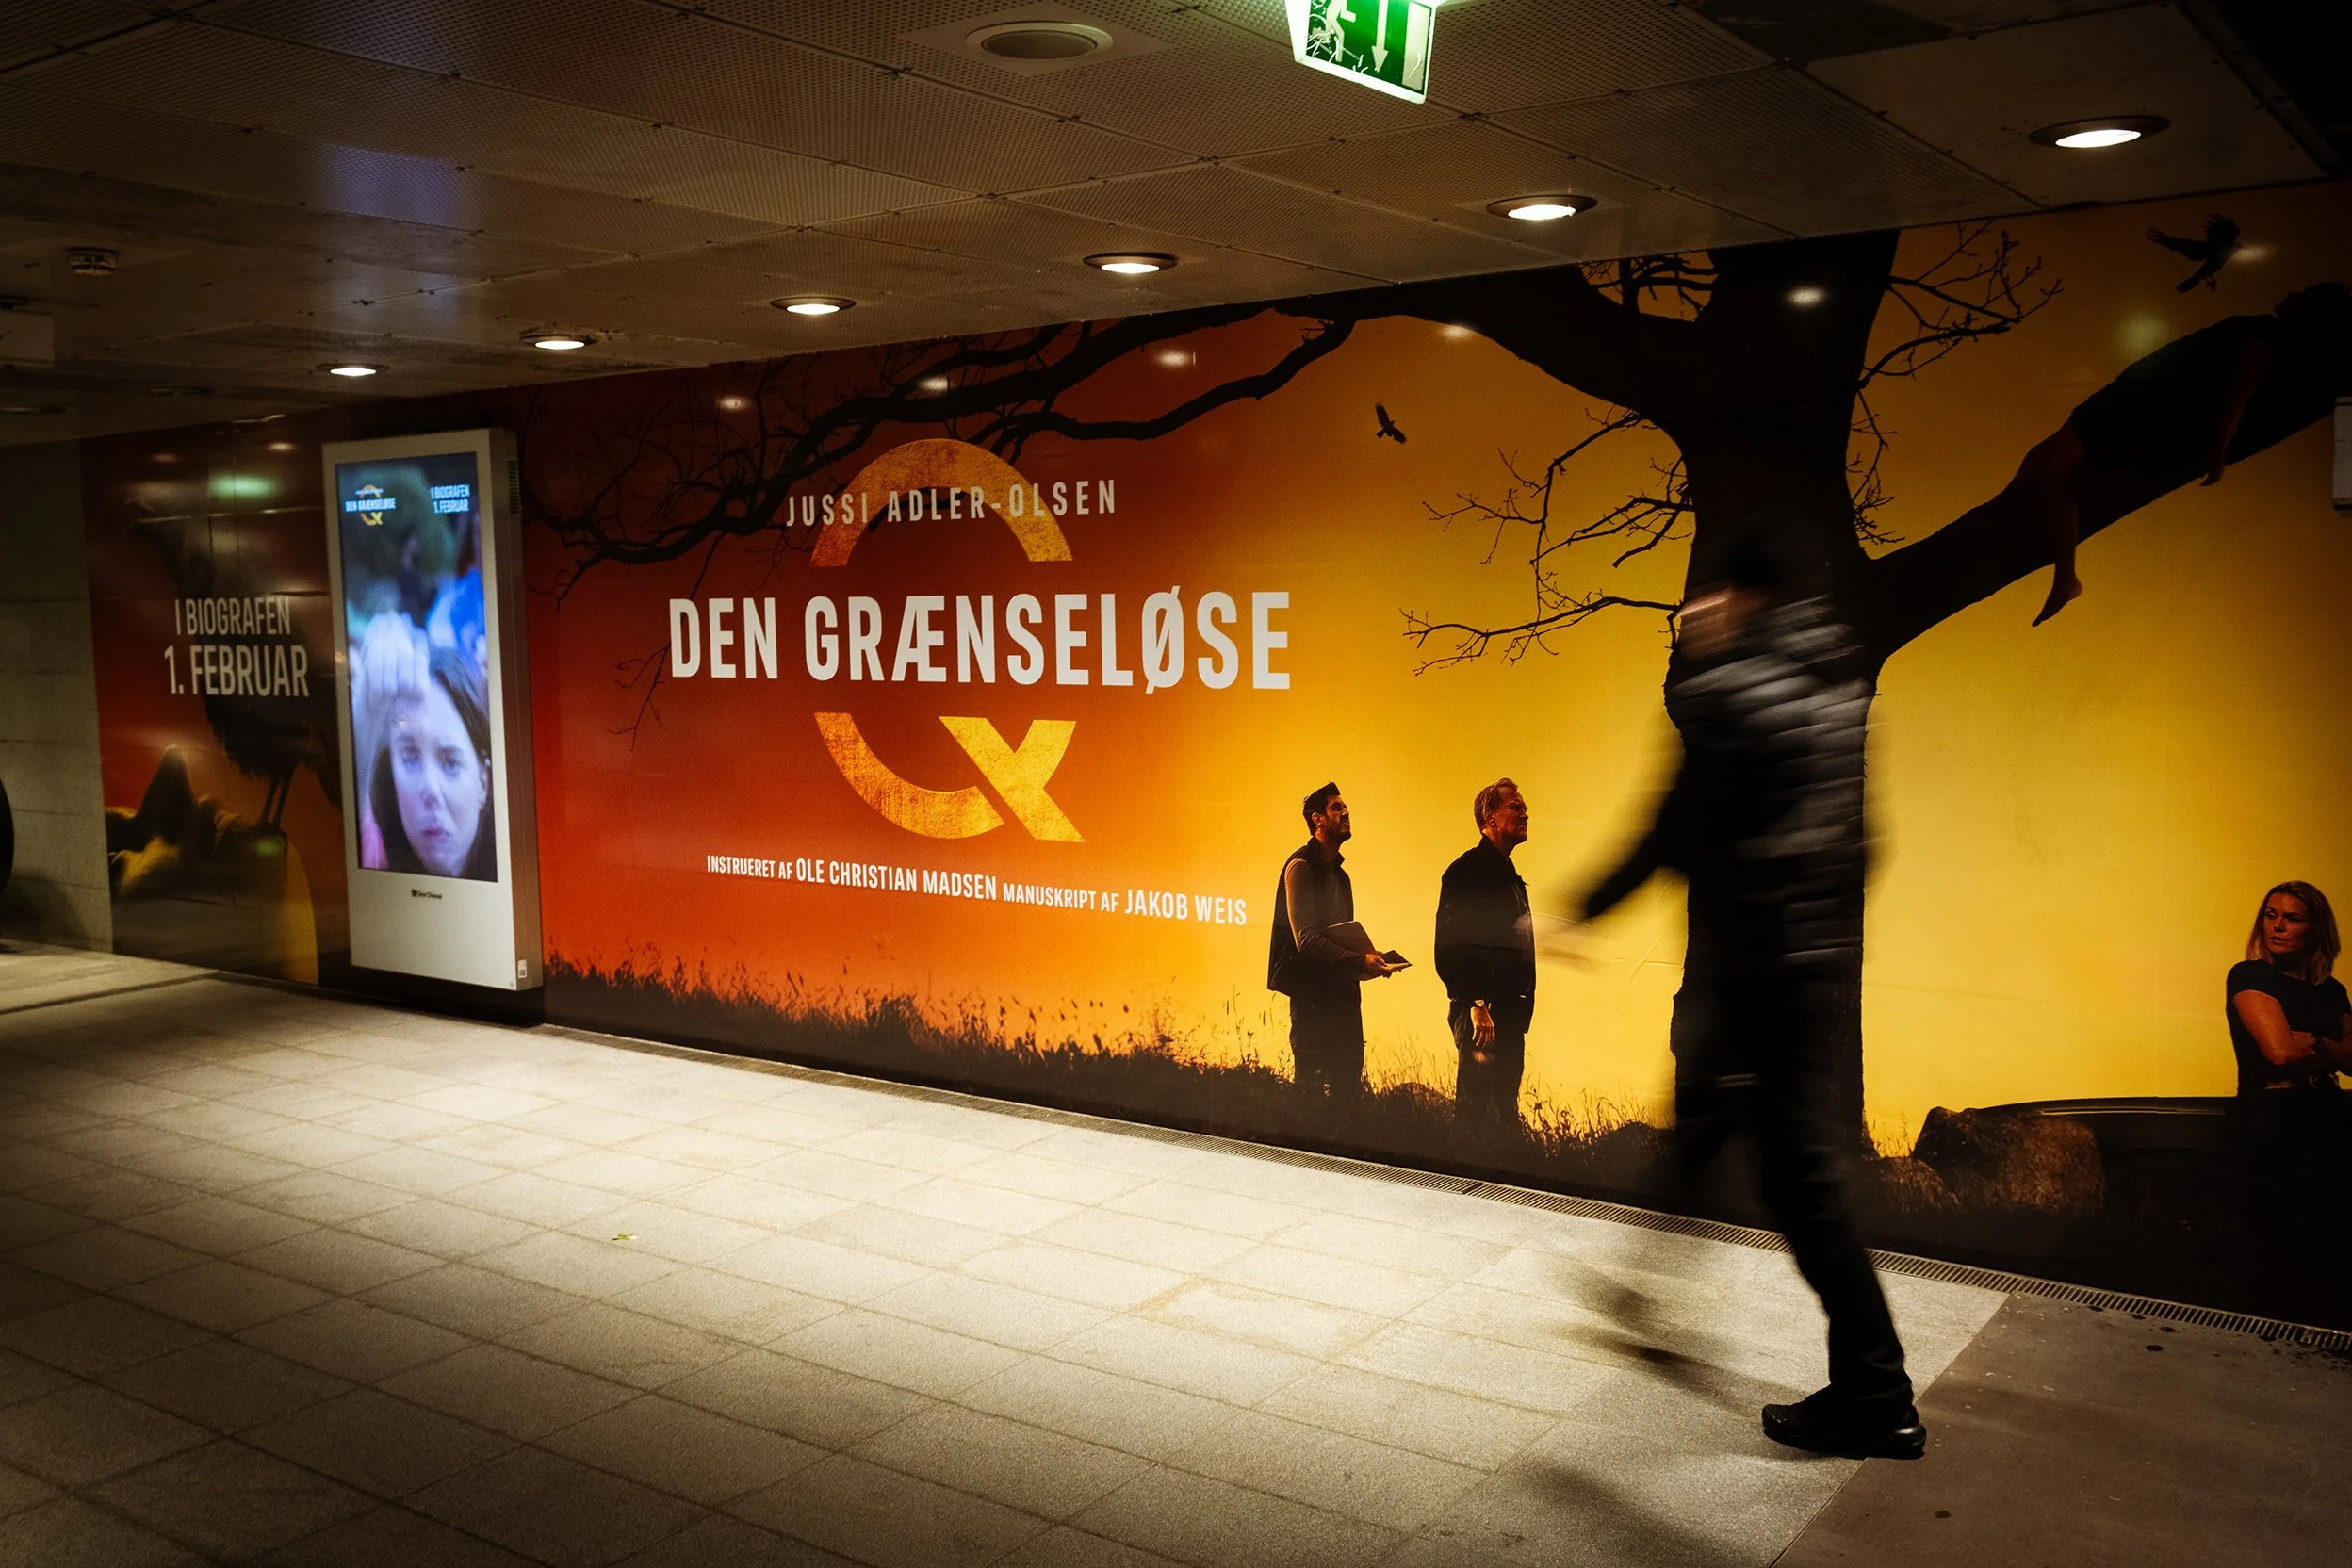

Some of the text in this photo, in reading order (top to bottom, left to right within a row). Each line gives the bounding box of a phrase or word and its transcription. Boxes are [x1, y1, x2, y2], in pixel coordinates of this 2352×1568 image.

[786, 479, 1116, 527] JUSSI ADLER-OLSEN
[174, 597, 291, 636] I BIOGRAFEN
[669, 585, 1290, 694] DEN GRÆNSELØSE
[164, 645, 310, 698] 1. FEBRUAR
[707, 855, 1248, 926] INSTRUERET AF OLE CHRISTIAN MADSEN MANUSKRIPT AF JAKOB WEIS
